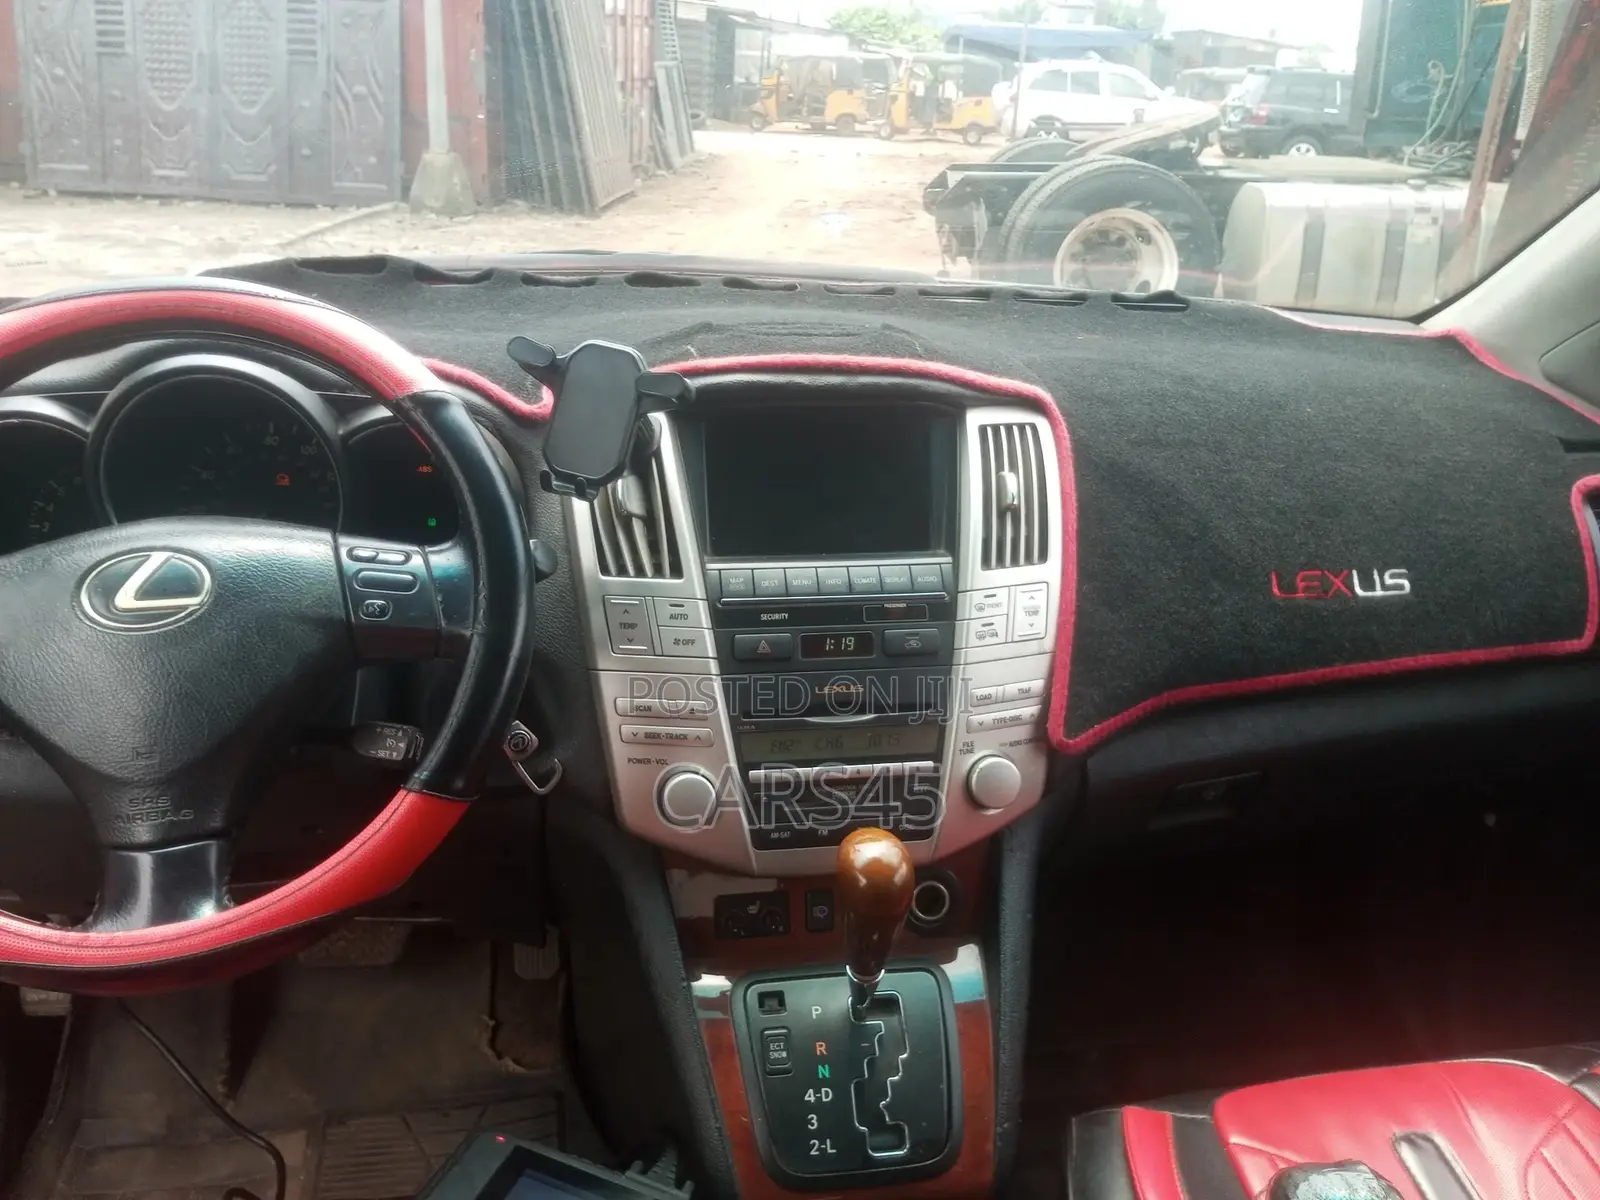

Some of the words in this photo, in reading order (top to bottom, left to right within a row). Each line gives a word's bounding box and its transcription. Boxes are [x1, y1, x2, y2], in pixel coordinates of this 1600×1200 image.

[792, 579, 812, 587] MENU
[1270, 568, 1411, 599] LEXUS
[669, 613, 689, 621] AUTO
[760, 612, 789, 621] SECURITY
[619, 622, 638, 630] TEMP
[682, 638, 696, 647] OFF
[826, 637, 855, 650] 1:19
[815, 684, 864, 694] LEXUS
[976, 693, 992, 701] LOAD
[634, 705, 652, 713] SCAN
[959, 747, 975, 755] TUNE
[812, 1006, 822, 1019] P
[769, 1042, 784, 1050] ECT
[815, 1042, 827, 1055] R
[769, 1051, 787, 1059] SNOW
[818, 1064, 830, 1078] N
[804, 1087, 833, 1103] 4-D
[807, 1114, 818, 1130] 3
[809, 1138, 837, 1155] 2-L
